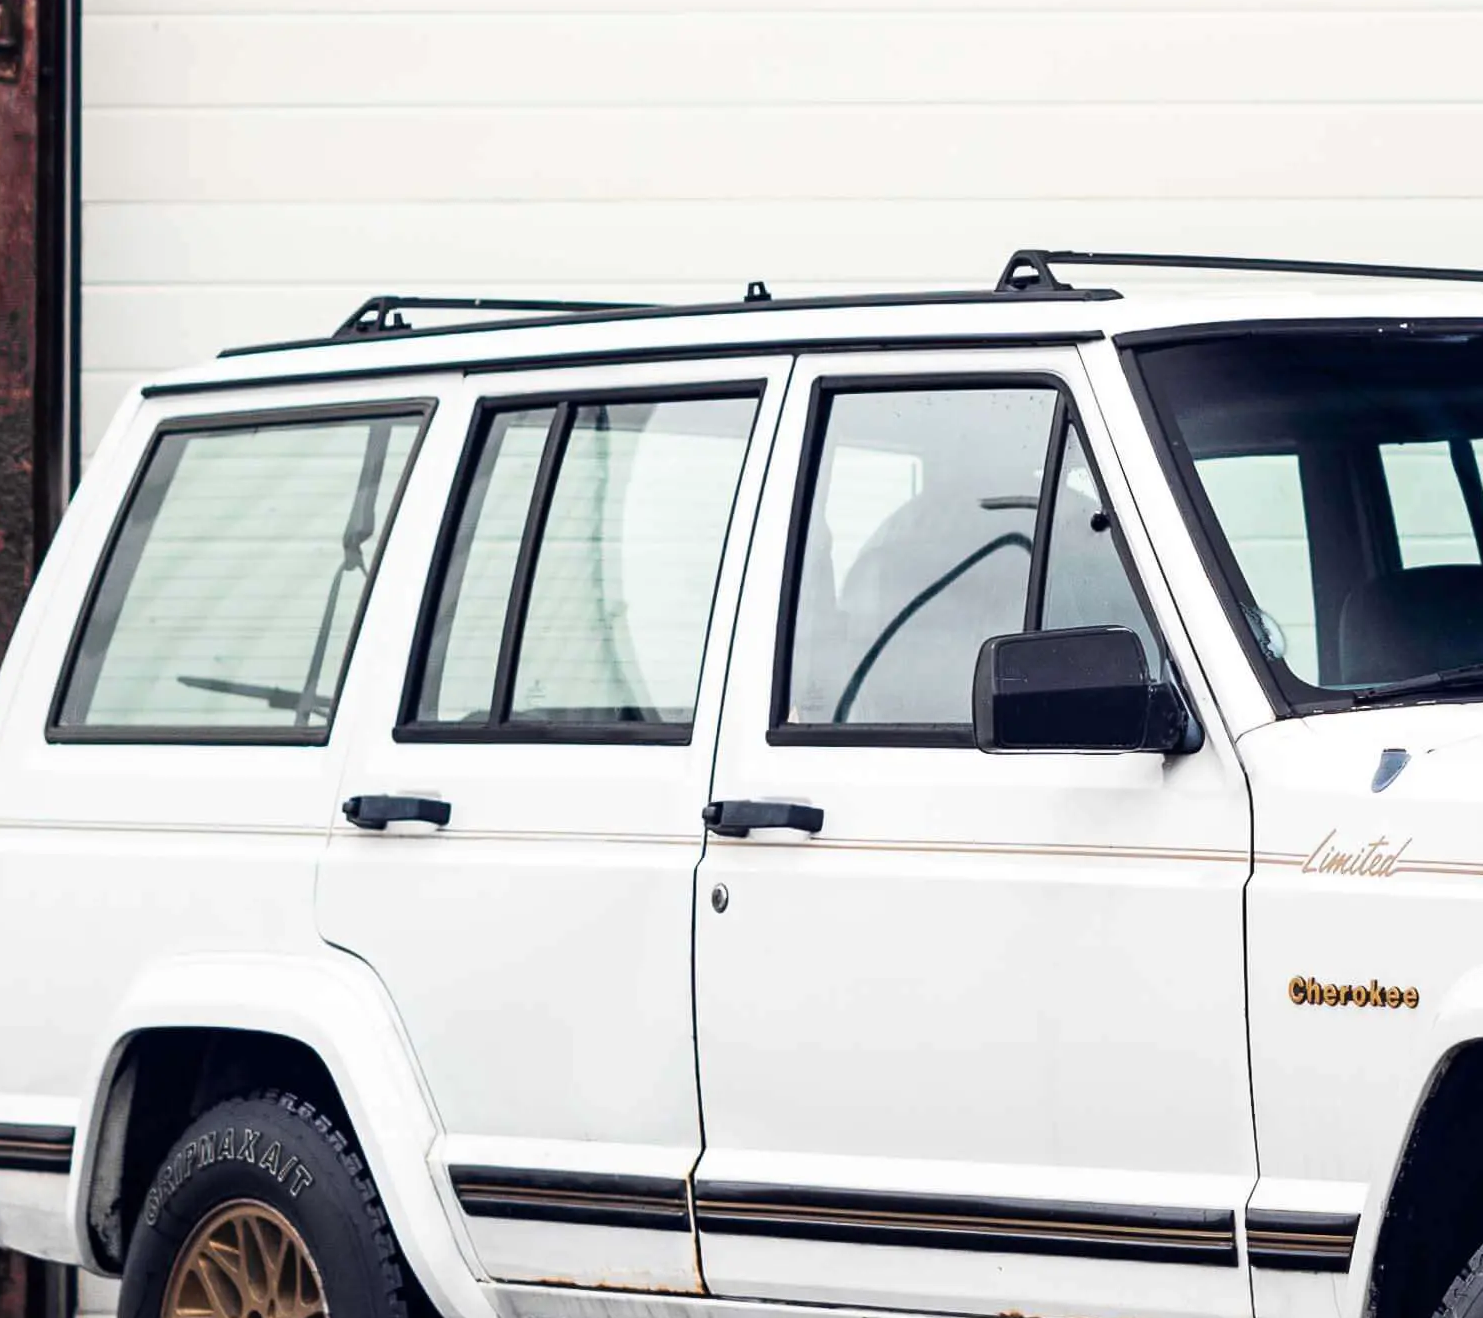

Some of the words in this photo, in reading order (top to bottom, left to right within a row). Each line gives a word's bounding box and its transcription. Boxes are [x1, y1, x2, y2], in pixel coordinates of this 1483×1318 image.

[1302, 828, 1413, 878] Limited
[1288, 975, 1420, 1009] Cherokee
[145, 1128, 261, 1226] GRIPMAX
